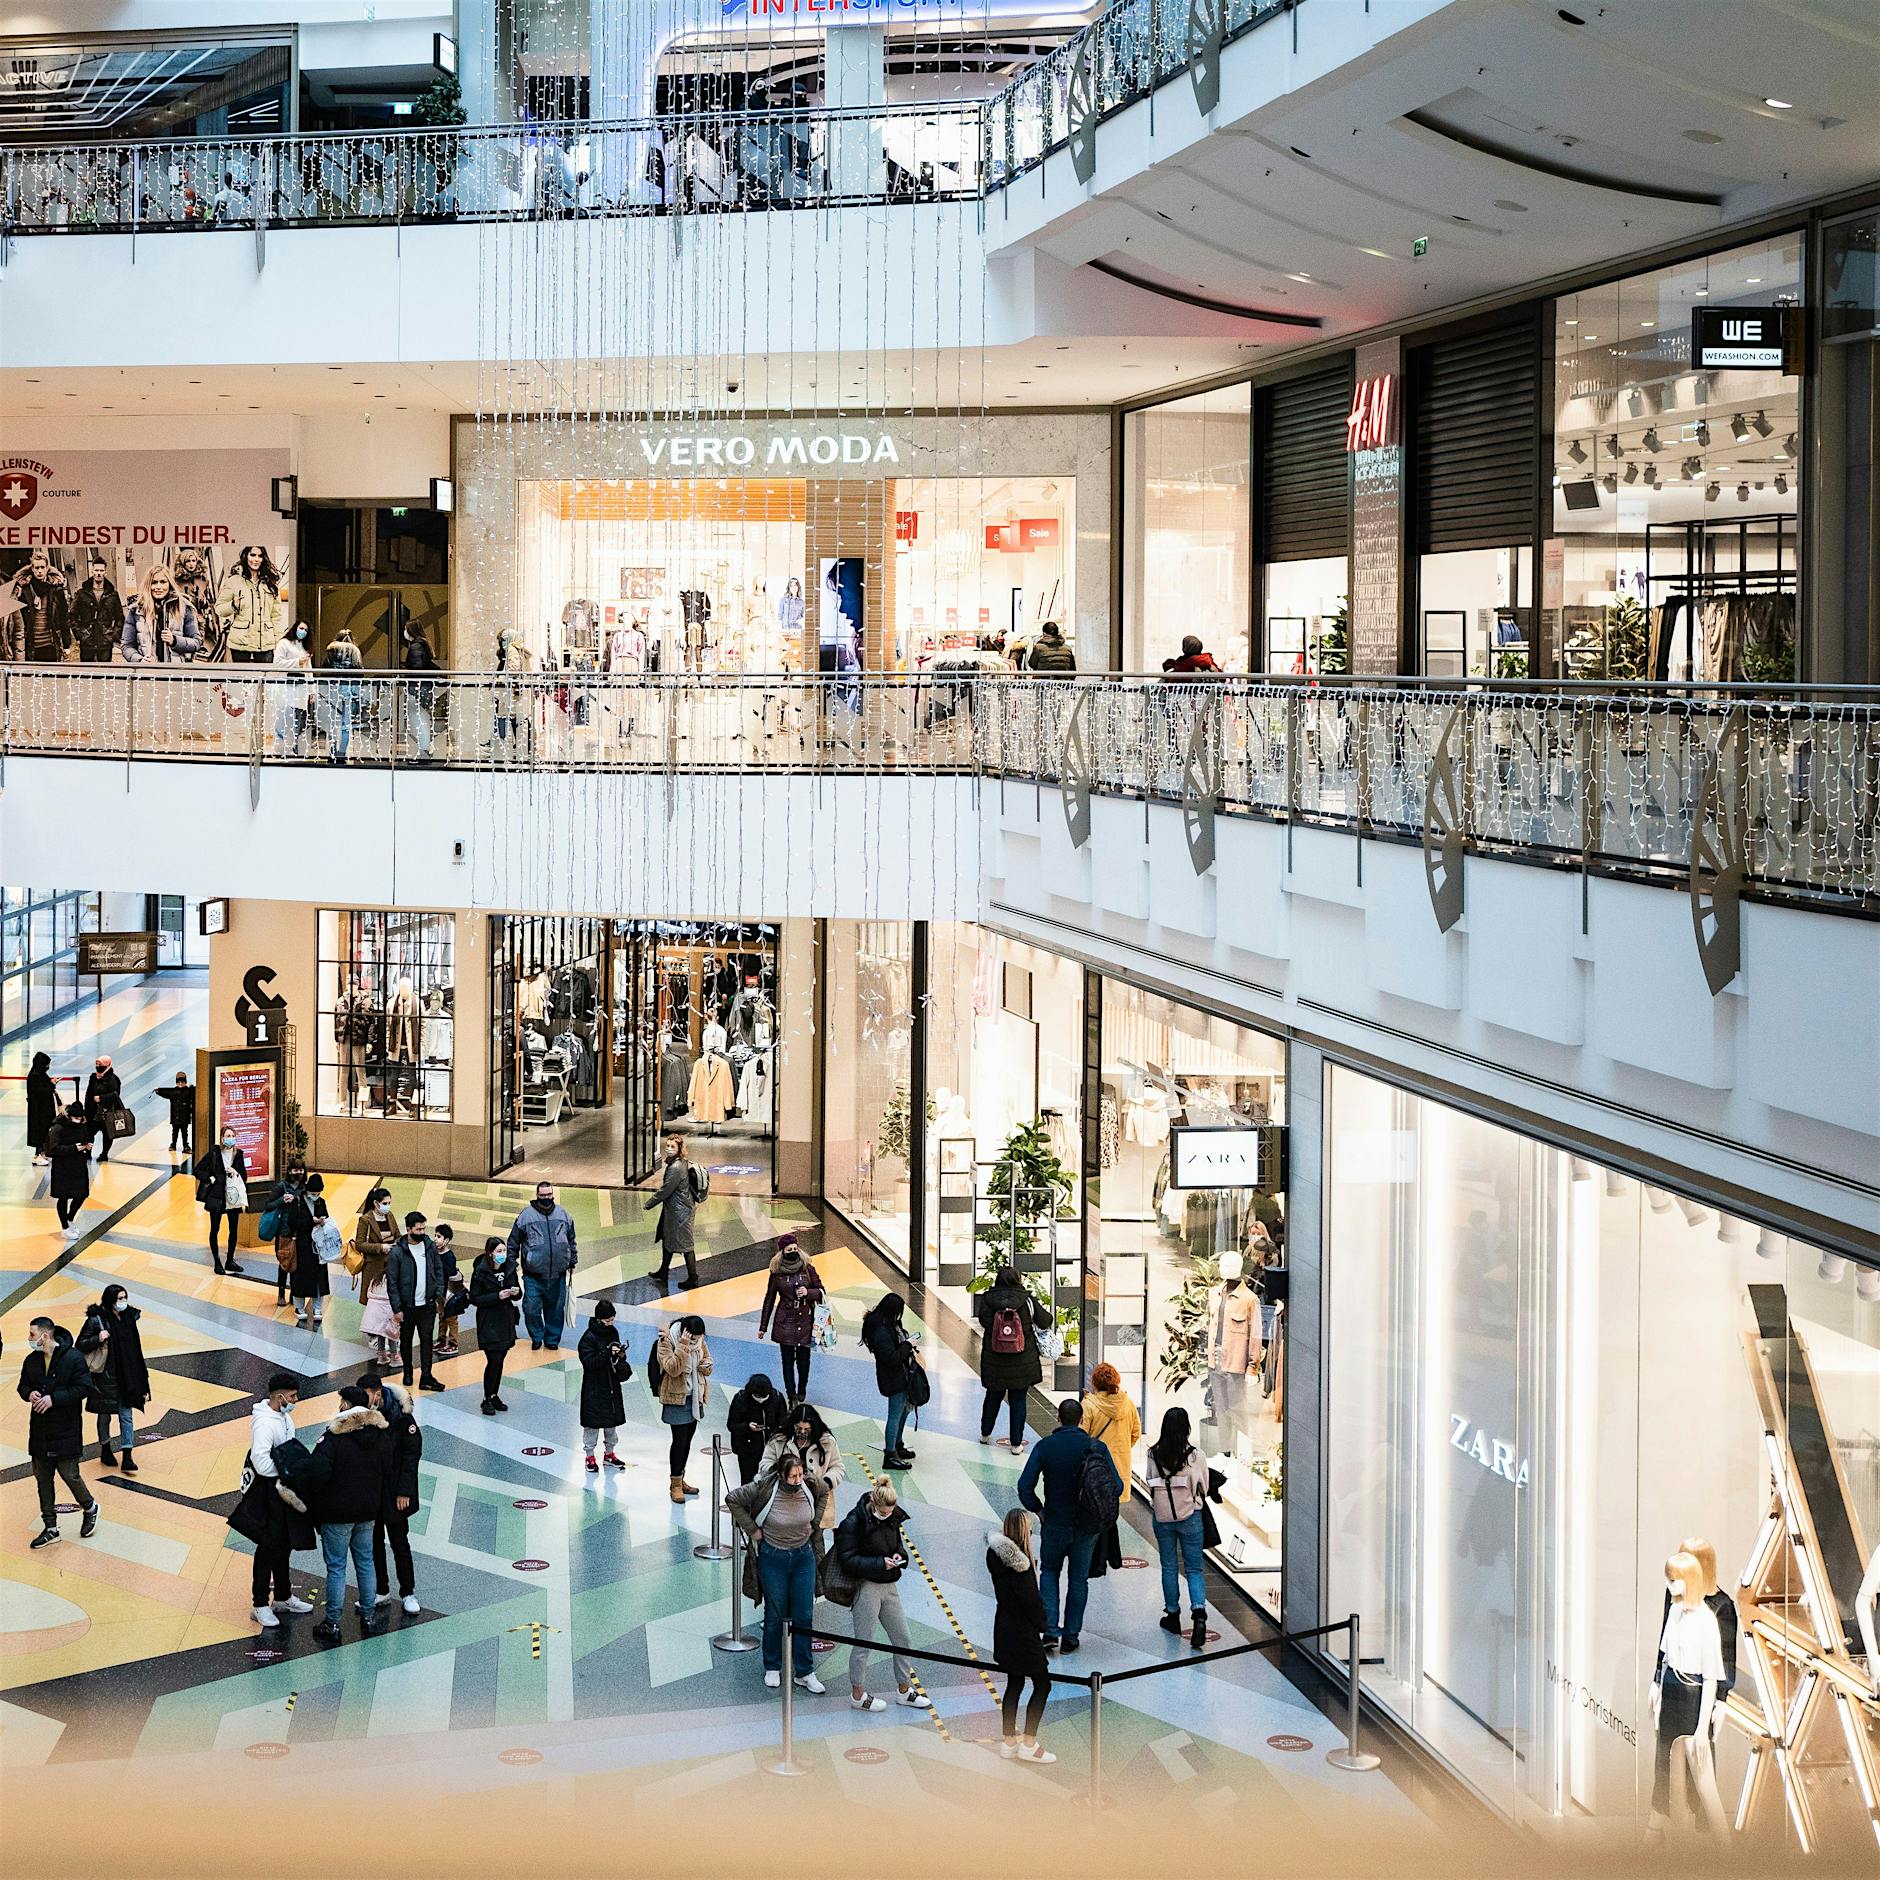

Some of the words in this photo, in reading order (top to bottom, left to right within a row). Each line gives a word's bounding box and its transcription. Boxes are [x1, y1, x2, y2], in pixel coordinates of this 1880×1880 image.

[1722, 320, 1762, 341] WE
[1704, 352, 1780, 361] WEFASHION.COM
[1346, 373, 1391, 452] H&M
[639, 435, 755, 466] VERO
[766, 434, 900, 465] MODA
[0, 458, 54, 480] LENSTEYN
[42, 490, 82, 498] COUTURE
[28, 526, 125, 545] FINDEST
[133, 526, 166, 545] DU
[174, 525, 236, 544] HIER.
[1028, 528, 1050, 538] Sale
[1450, 1413, 1529, 1489] ZARA
[1581, 1685, 1636, 1748] Christmas
